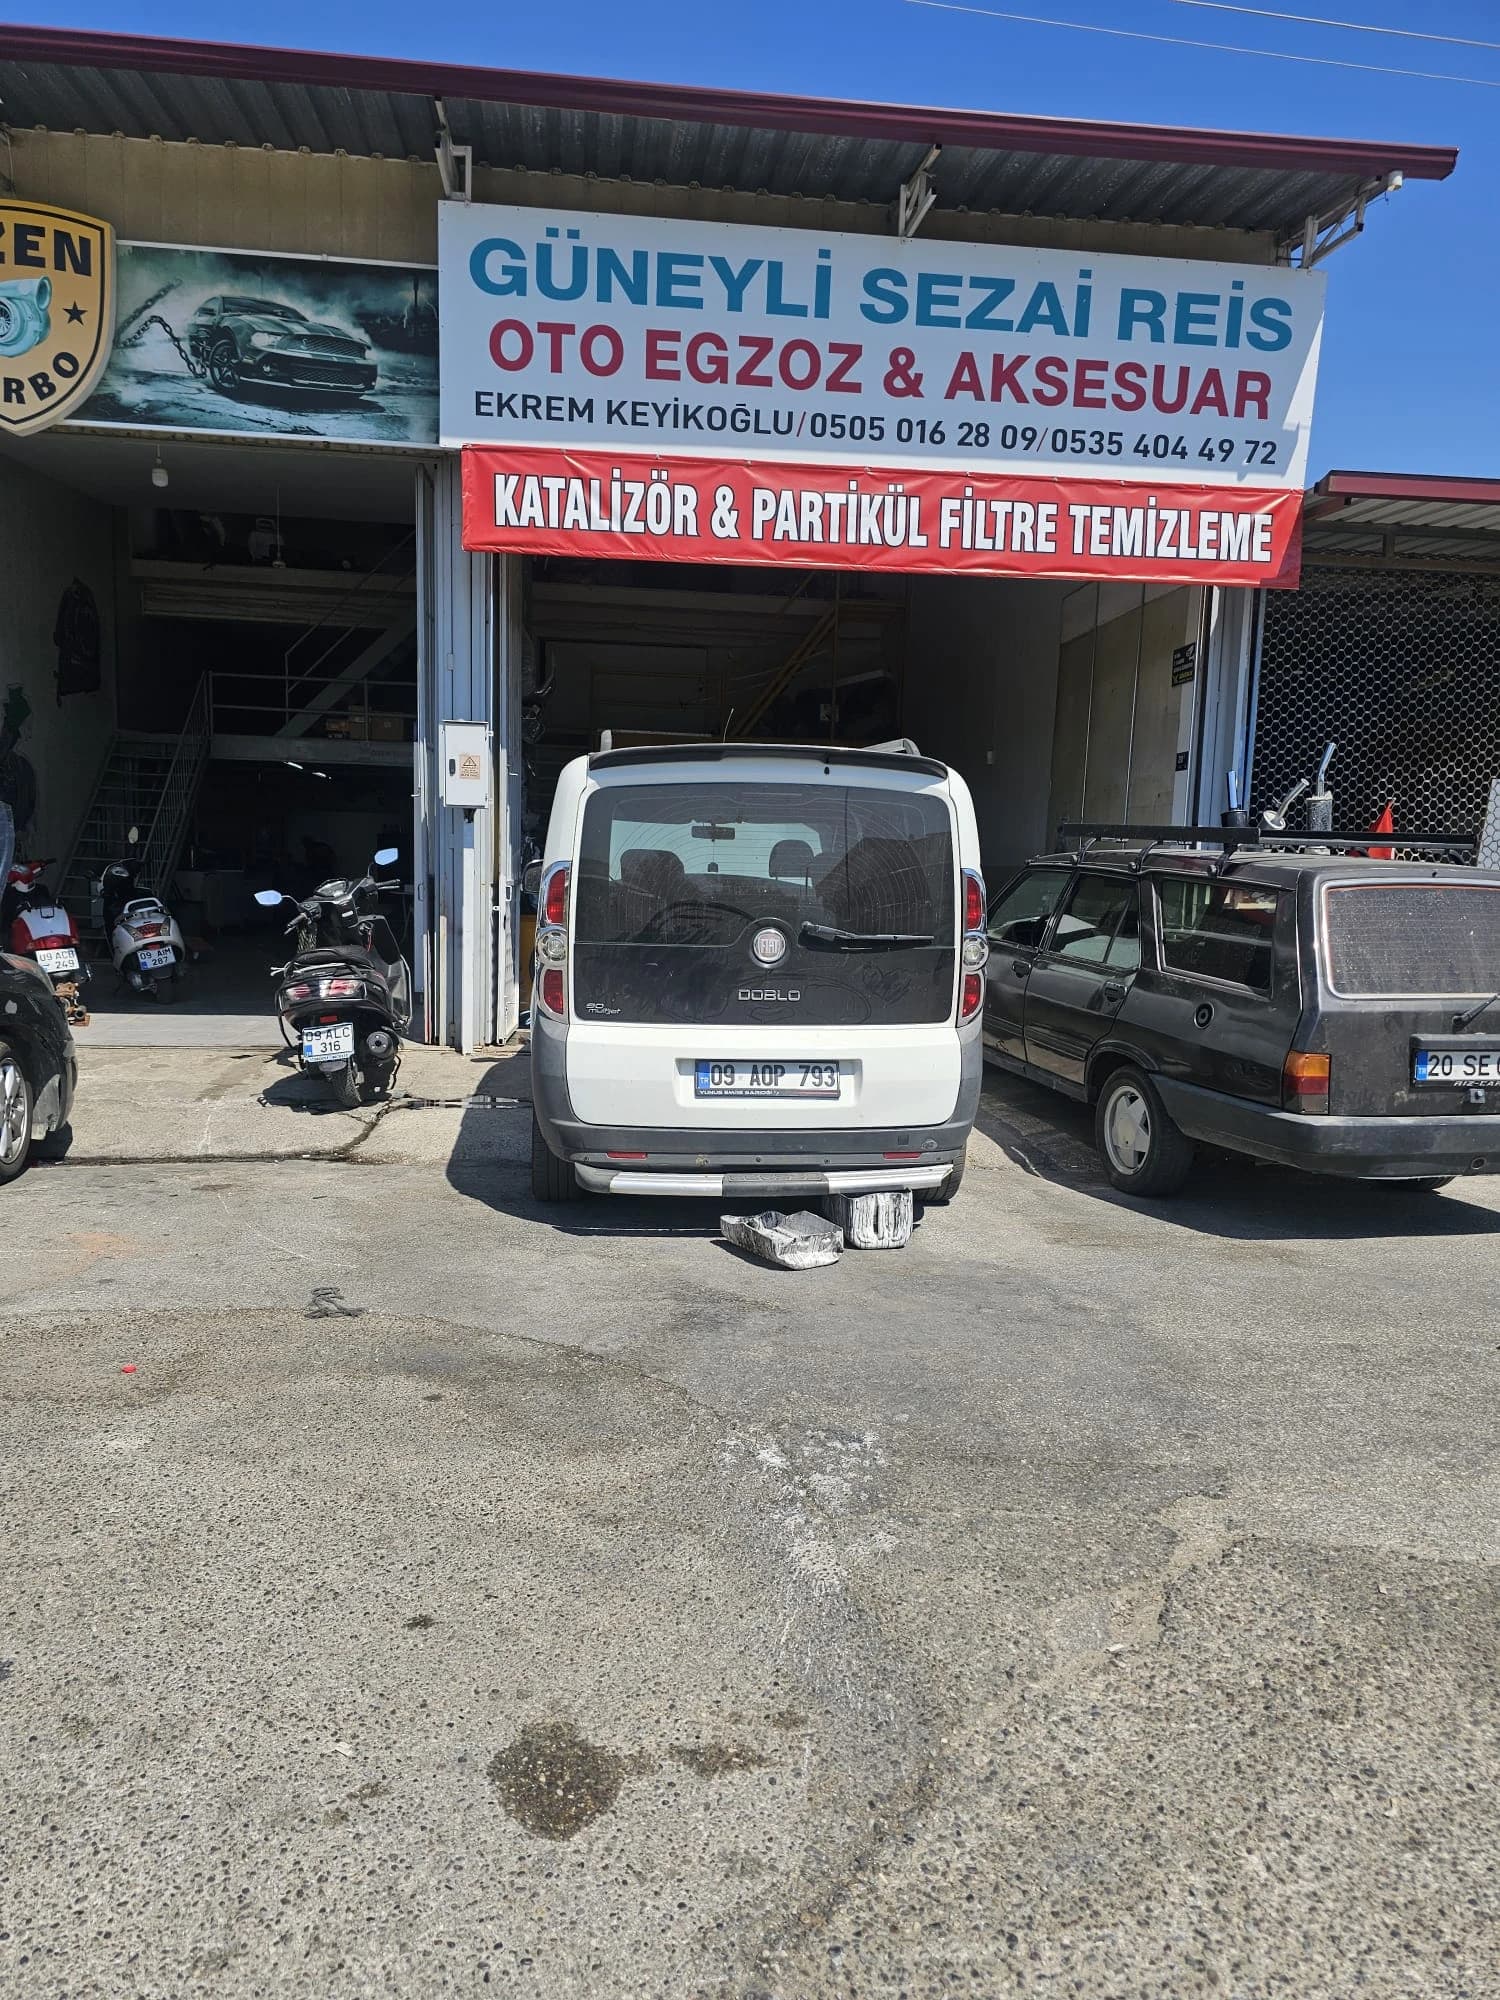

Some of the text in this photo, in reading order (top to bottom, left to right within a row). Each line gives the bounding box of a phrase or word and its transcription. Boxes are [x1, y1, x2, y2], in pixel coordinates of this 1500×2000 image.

[0, 221, 92, 277] EN
[469, 228, 1294, 353] GÜNEYLİ SEZAİ REİS
[488, 318, 1272, 420] OTO EGZOZ & AKSESUAR
[475, 391, 595, 424] EKREM
[896, 418, 946, 445] 016
[957, 422, 990, 448] 28
[1133, 433, 1188, 460] 404
[1198, 437, 1235, 463] 49
[1245, 440, 1277, 465] 72
[494, 467, 1274, 563] KATALİZÖR & PARTİKÜL FİLTRE TEMİZLEME
[738, 989, 801, 1002] DOBLO
[305, 1026, 351, 1042] 09 ALC
[320, 1040, 341, 1053] 316
[710, 1064, 836, 1087] 09 AOP 793
[1428, 1054, 1453, 1077] 20
